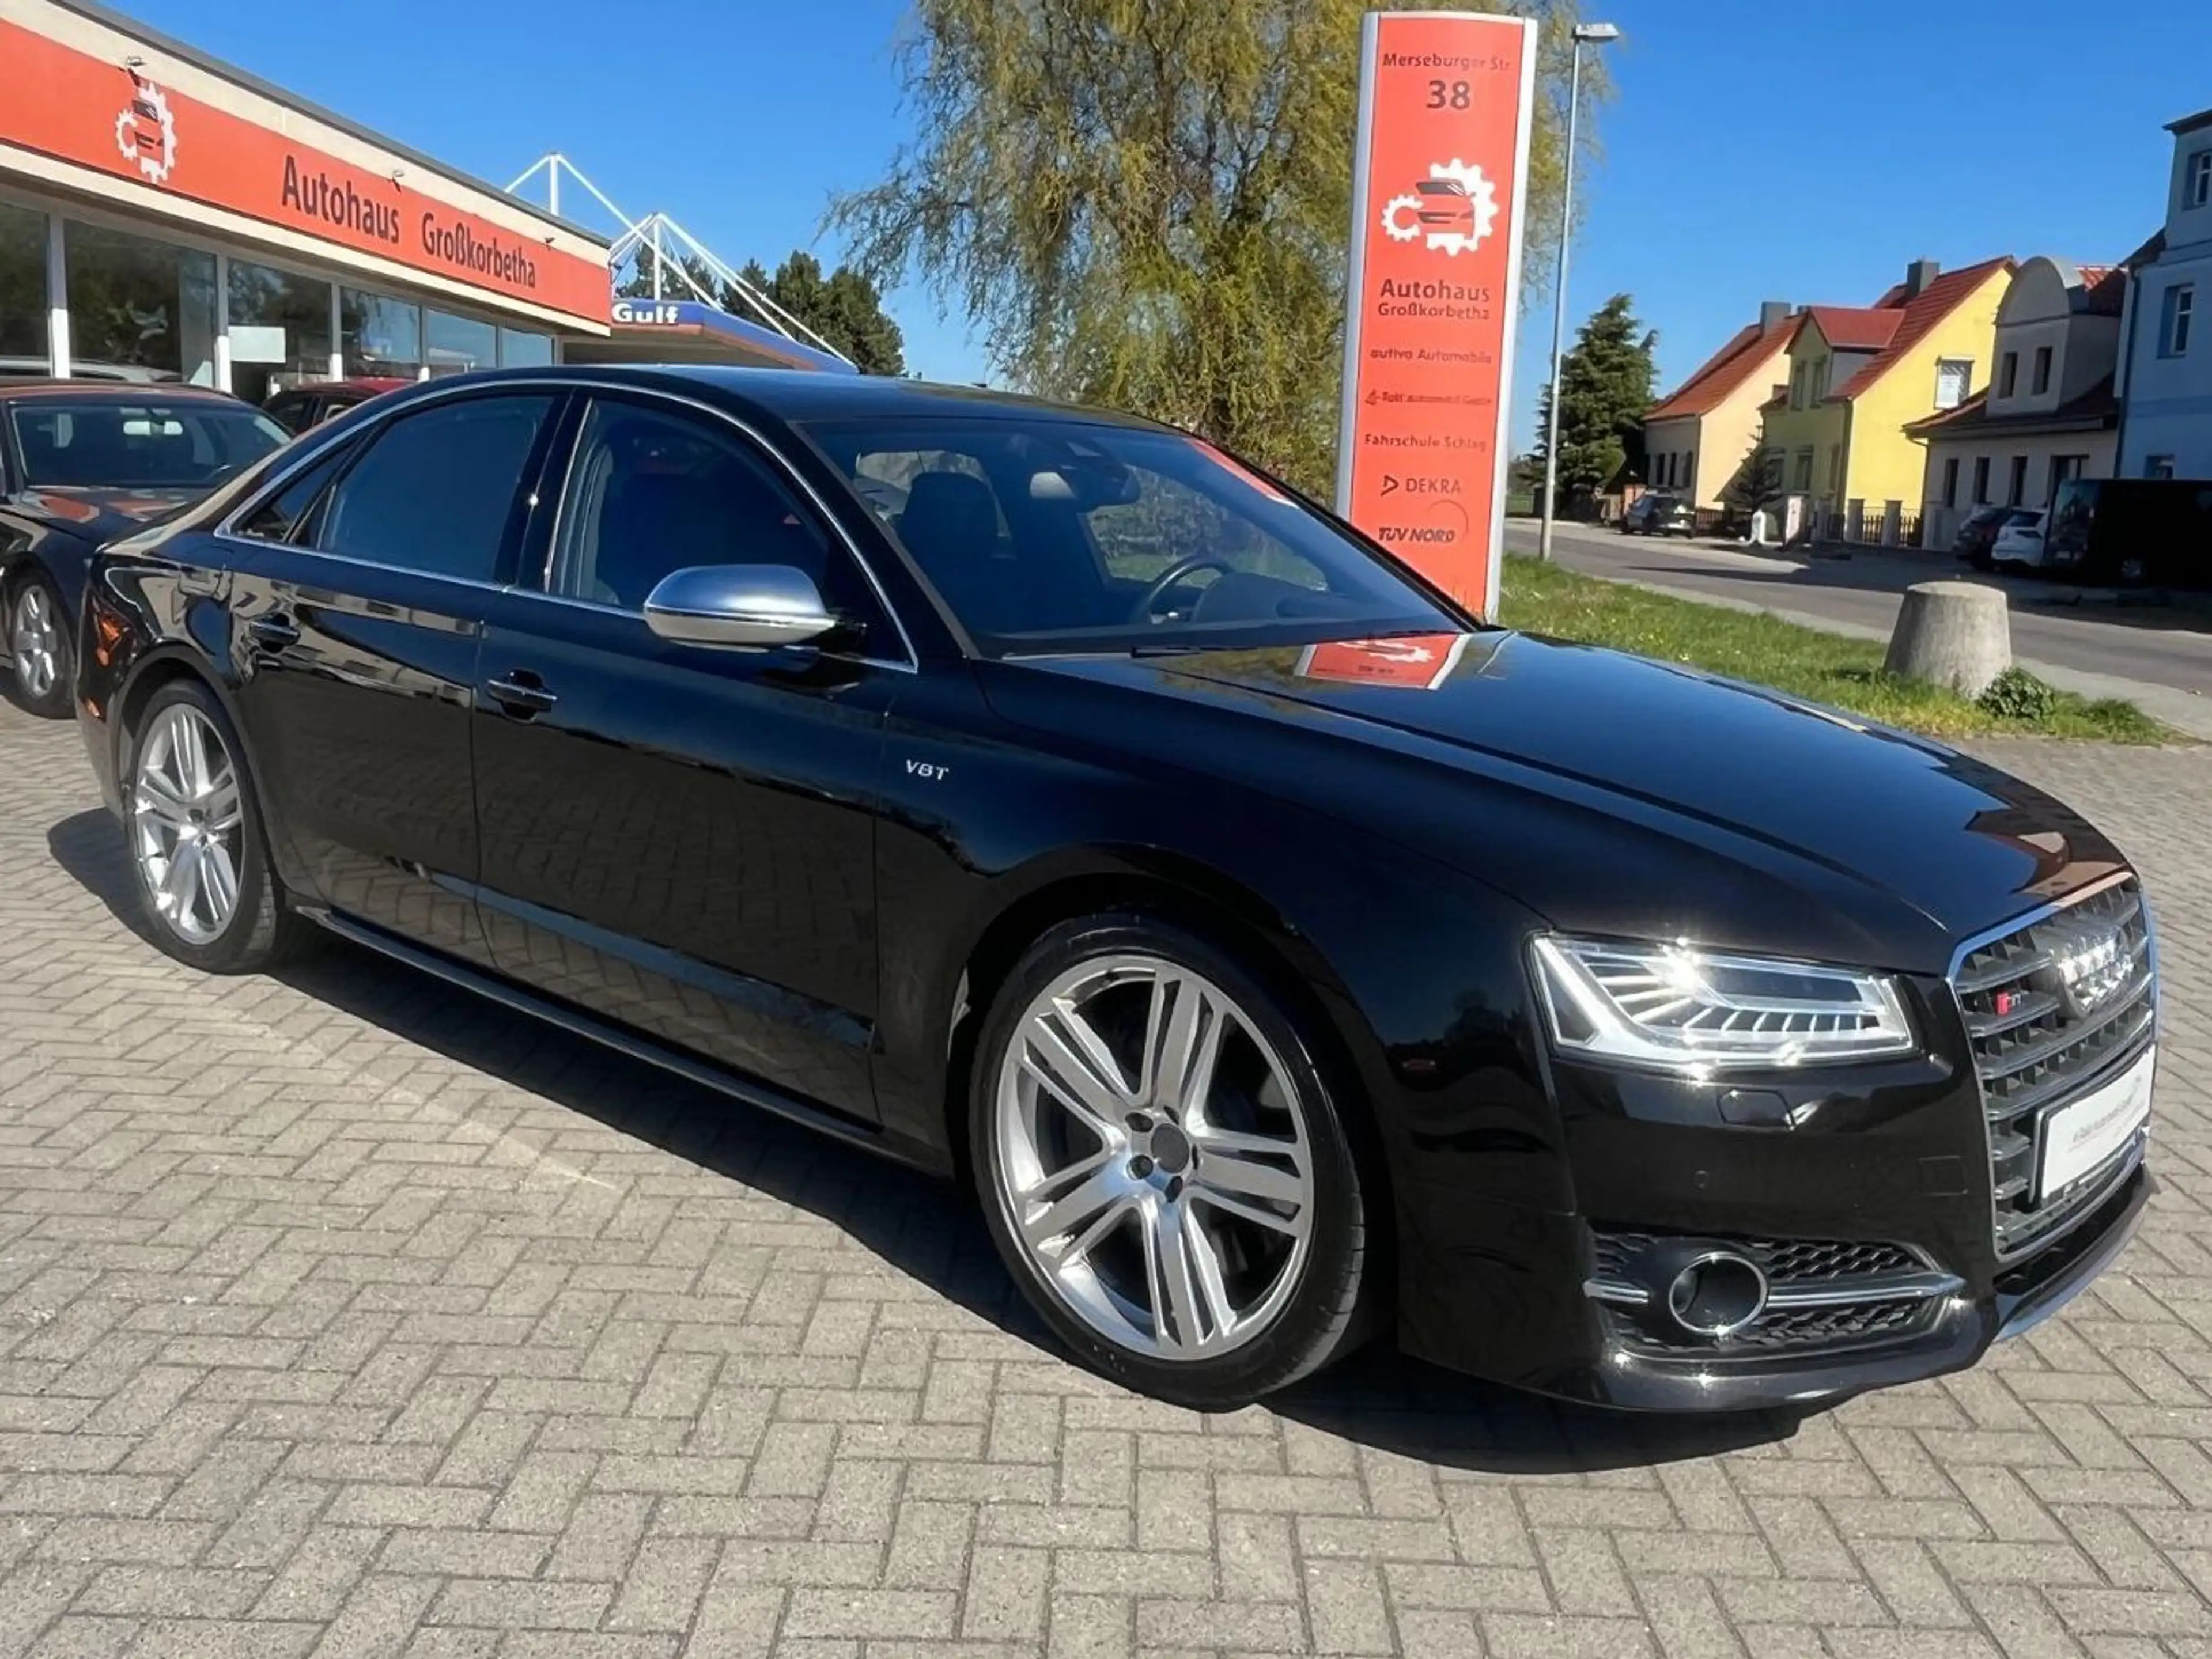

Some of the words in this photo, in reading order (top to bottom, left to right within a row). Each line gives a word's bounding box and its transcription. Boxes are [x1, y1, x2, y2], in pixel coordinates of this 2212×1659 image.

[1427, 79, 1471, 109] 38
[282, 154, 400, 243] Autohaus
[422, 211, 536, 288] Großkorbetha
[1381, 278, 1491, 303] Autohaus
[611, 303, 678, 324] Gulf
[1378, 302, 1490, 320] Großkorbetha
[1364, 433, 1440, 448] Fahrschule
[1406, 478, 1462, 494] DEKRA
[1409, 528, 1455, 542] NORD
